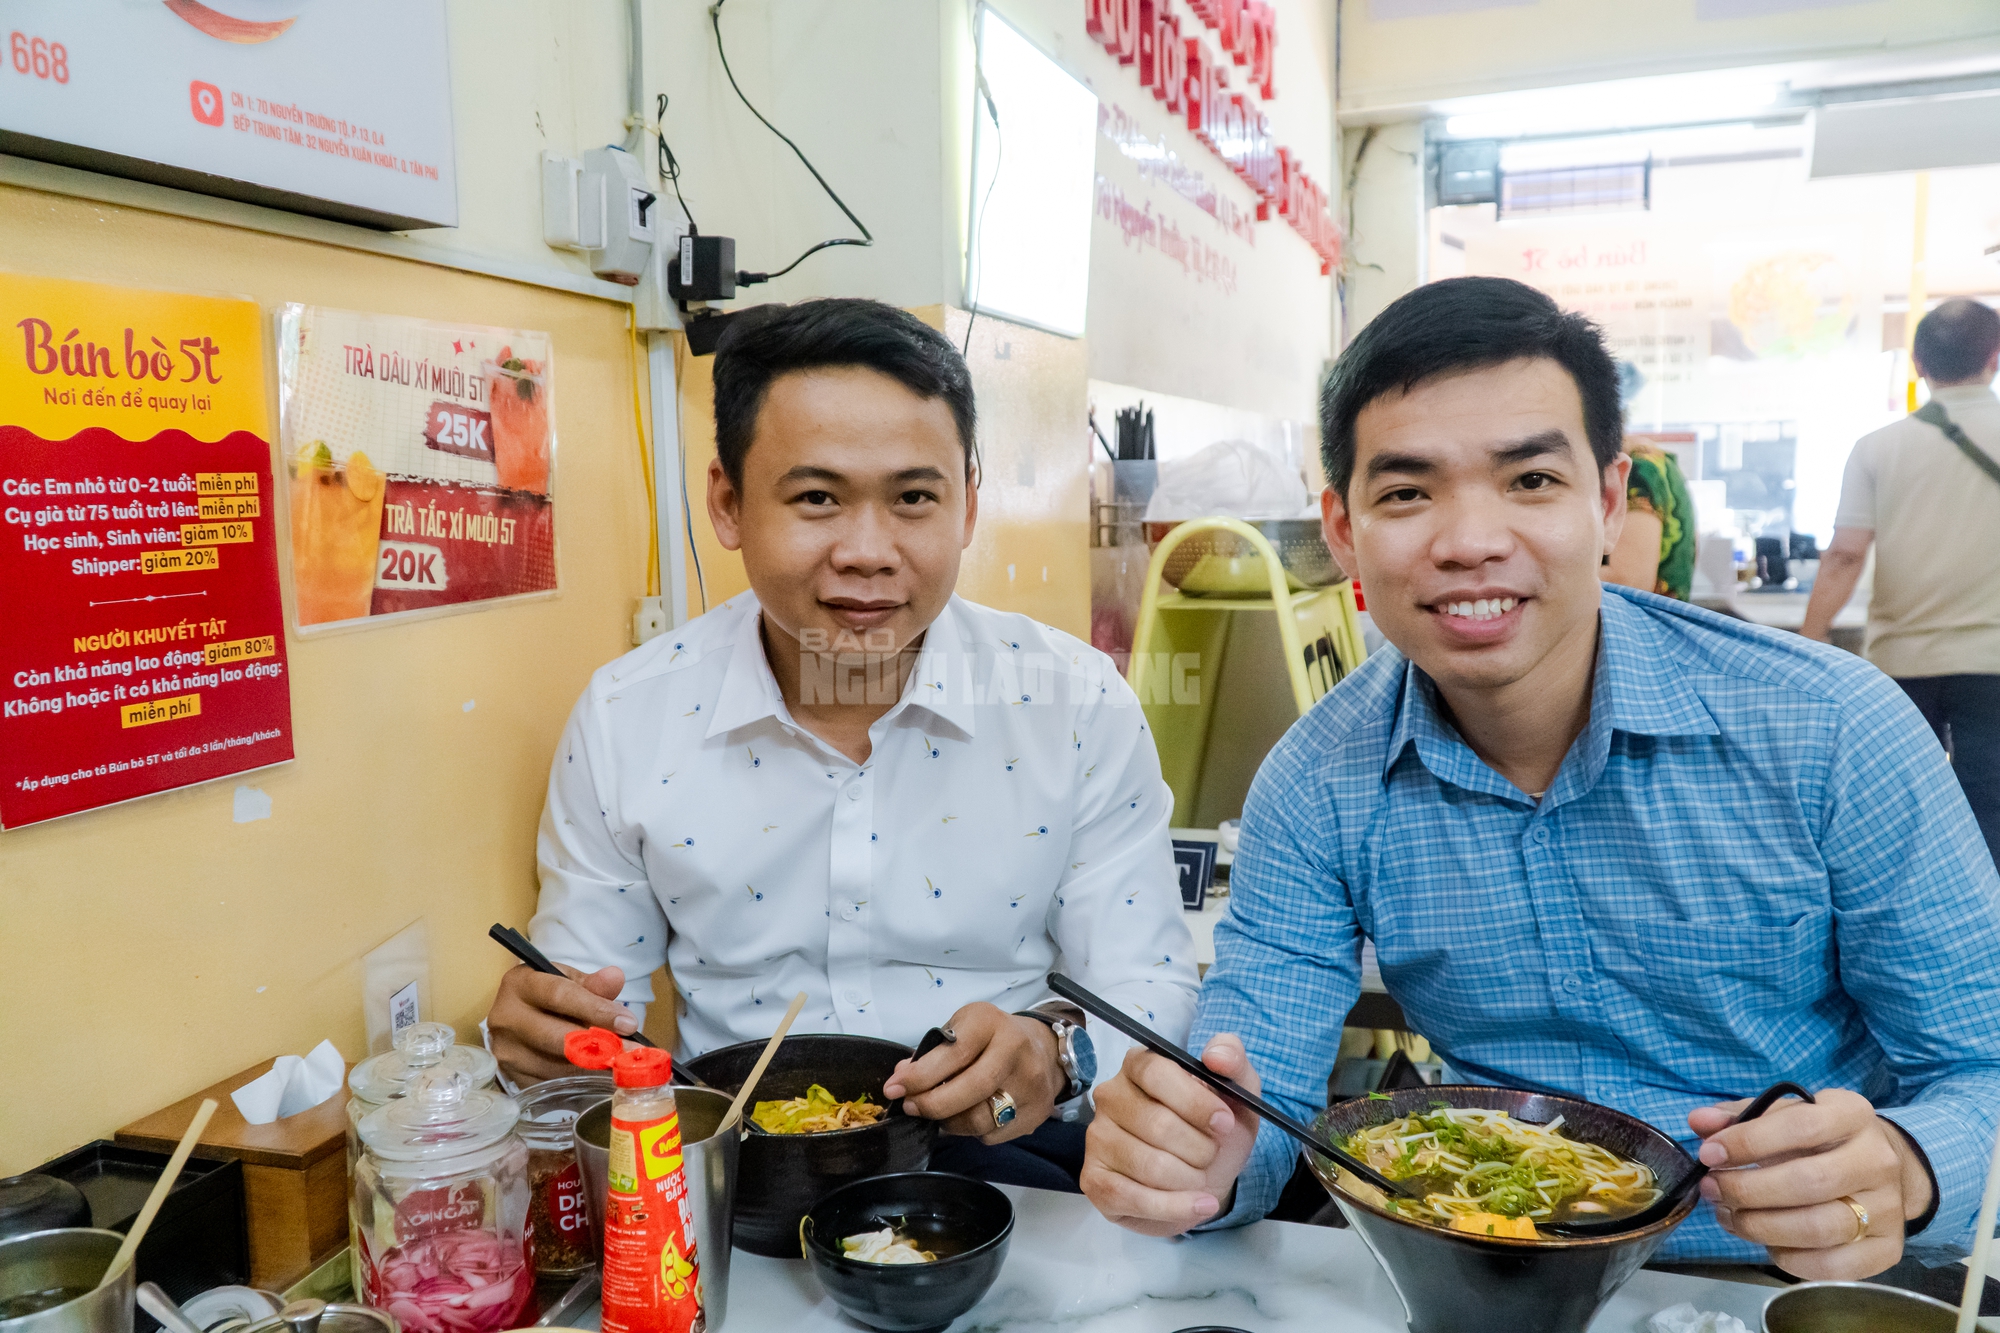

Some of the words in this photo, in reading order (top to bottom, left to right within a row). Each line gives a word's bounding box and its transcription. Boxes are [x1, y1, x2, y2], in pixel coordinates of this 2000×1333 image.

[10, 30, 69, 84] 668
[231, 91, 244, 108] CN
[256, 98, 268, 115] 70
[269, 103, 303, 124] NGUYỄN
[233, 113, 250, 132] BẾP
[252, 119, 282, 141] TRUNG
[306, 133, 316, 150] 32
[409, 160, 423, 177] TÂN
[16, 317, 119, 379] Bún
[123, 327, 176, 381] bò
[180, 336, 223, 385] 5t
[343, 343, 375, 379] TRÀ
[380, 350, 410, 386] DÂU
[415, 358, 429, 390] XÍ
[431, 365, 465, 402] MUỘI
[469, 374, 485, 402] 5T
[43, 387, 76, 405] Nơi
[82, 386, 116, 407] đến
[121, 387, 143, 408] để
[148, 395, 188, 413] quay
[192, 394, 211, 415] lại
[436, 411, 488, 451] 25K
[2, 478, 42, 496] Các
[44, 478, 72, 495] Em
[75, 476, 106, 494] nhỏ
[108, 476, 127, 494] từ
[128, 477, 159, 493] 0-2
[162, 473, 196, 493] tuổi:
[199, 473, 232, 491] miễn
[235, 476, 255, 493] phí
[4, 507, 31, 528] Cụ
[35, 505, 64, 527] già
[66, 505, 85, 521] từ
[87, 504, 109, 521] 75
[111, 499, 143, 520] tuổi
[146, 501, 169, 519] trở
[172, 501, 199, 517] lên:
[202, 498, 234, 515] miễn
[237, 500, 257, 518] phí
[385, 500, 415, 535] TRÀ
[418, 498, 447, 538] TẮC
[449, 507, 465, 540] XÍ
[466, 510, 499, 548] MUỘI
[500, 517, 517, 545] 5T
[24, 534, 60, 555] Học
[63, 532, 104, 549] sinh,
[106, 529, 141, 546] Sinh
[144, 527, 180, 544] viên:
[184, 525, 218, 544] giảm
[222, 524, 248, 539] 10%
[71, 557, 141, 577] Shipper:
[145, 552, 181, 572] giảm
[185, 550, 216, 566] 20%
[381, 547, 437, 585] 20K
[73, 628, 131, 653] NGƯỜI
[133, 617, 197, 645] KHUYẾT
[199, 617, 227, 640] TẬT
[13, 669, 51, 688] Còn
[54, 662, 88, 683] khả
[91, 659, 132, 677] năng
[135, 655, 160, 671] lao
[163, 650, 205, 670] động:
[208, 643, 242, 663] giảm
[245, 638, 273, 654] 80%
[4, 696, 62, 718] Không
[65, 687, 111, 709] hoặc
[114, 684, 127, 701] ít
[129, 680, 149, 698] có
[152, 674, 181, 694] khả
[183, 672, 218, 688] năng
[221, 668, 242, 683] lao
[245, 662, 282, 681] động:
[129, 701, 165, 723] miễn
[169, 698, 191, 718] phí
[40, 774, 69, 788] dụng
[70, 768, 93, 781] cho
[94, 764, 107, 776] tô
[108, 761, 129, 774] Bún
[130, 757, 145, 769] bò
[146, 754, 159, 766] 5T
[161, 751, 173, 762] và
[174, 747, 187, 760] tối
[188, 745, 201, 757] đa
[202, 743, 209, 753] 3
[209, 727, 281, 752] lần/tháng/khách
